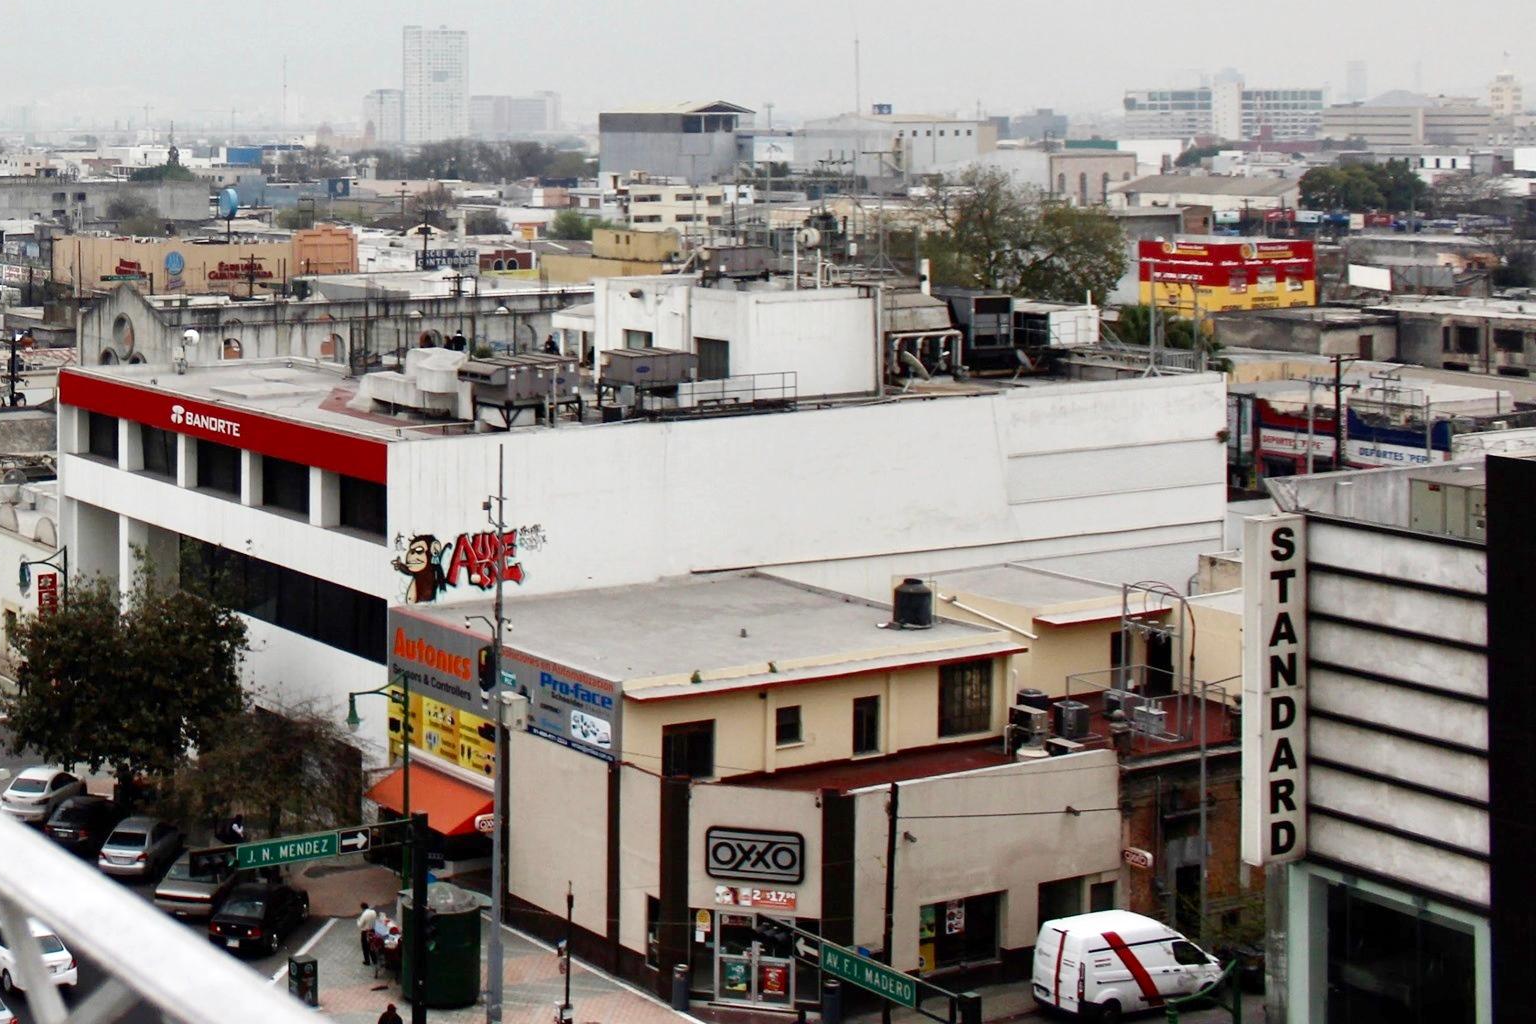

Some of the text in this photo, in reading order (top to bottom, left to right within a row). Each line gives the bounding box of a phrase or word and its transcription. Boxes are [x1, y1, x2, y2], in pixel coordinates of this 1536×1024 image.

[185, 411, 241, 437] BANORTE
[393, 626, 473, 682] Autonics
[540, 671, 613, 710] Pro-face
[1268, 526, 1298, 856] STANDARD
[247, 838, 328, 864] J. N. MENDEZ
[711, 841, 797, 871] OXXO
[826, 951, 840, 969] AV.
[865, 968, 912, 1000] MADERO
